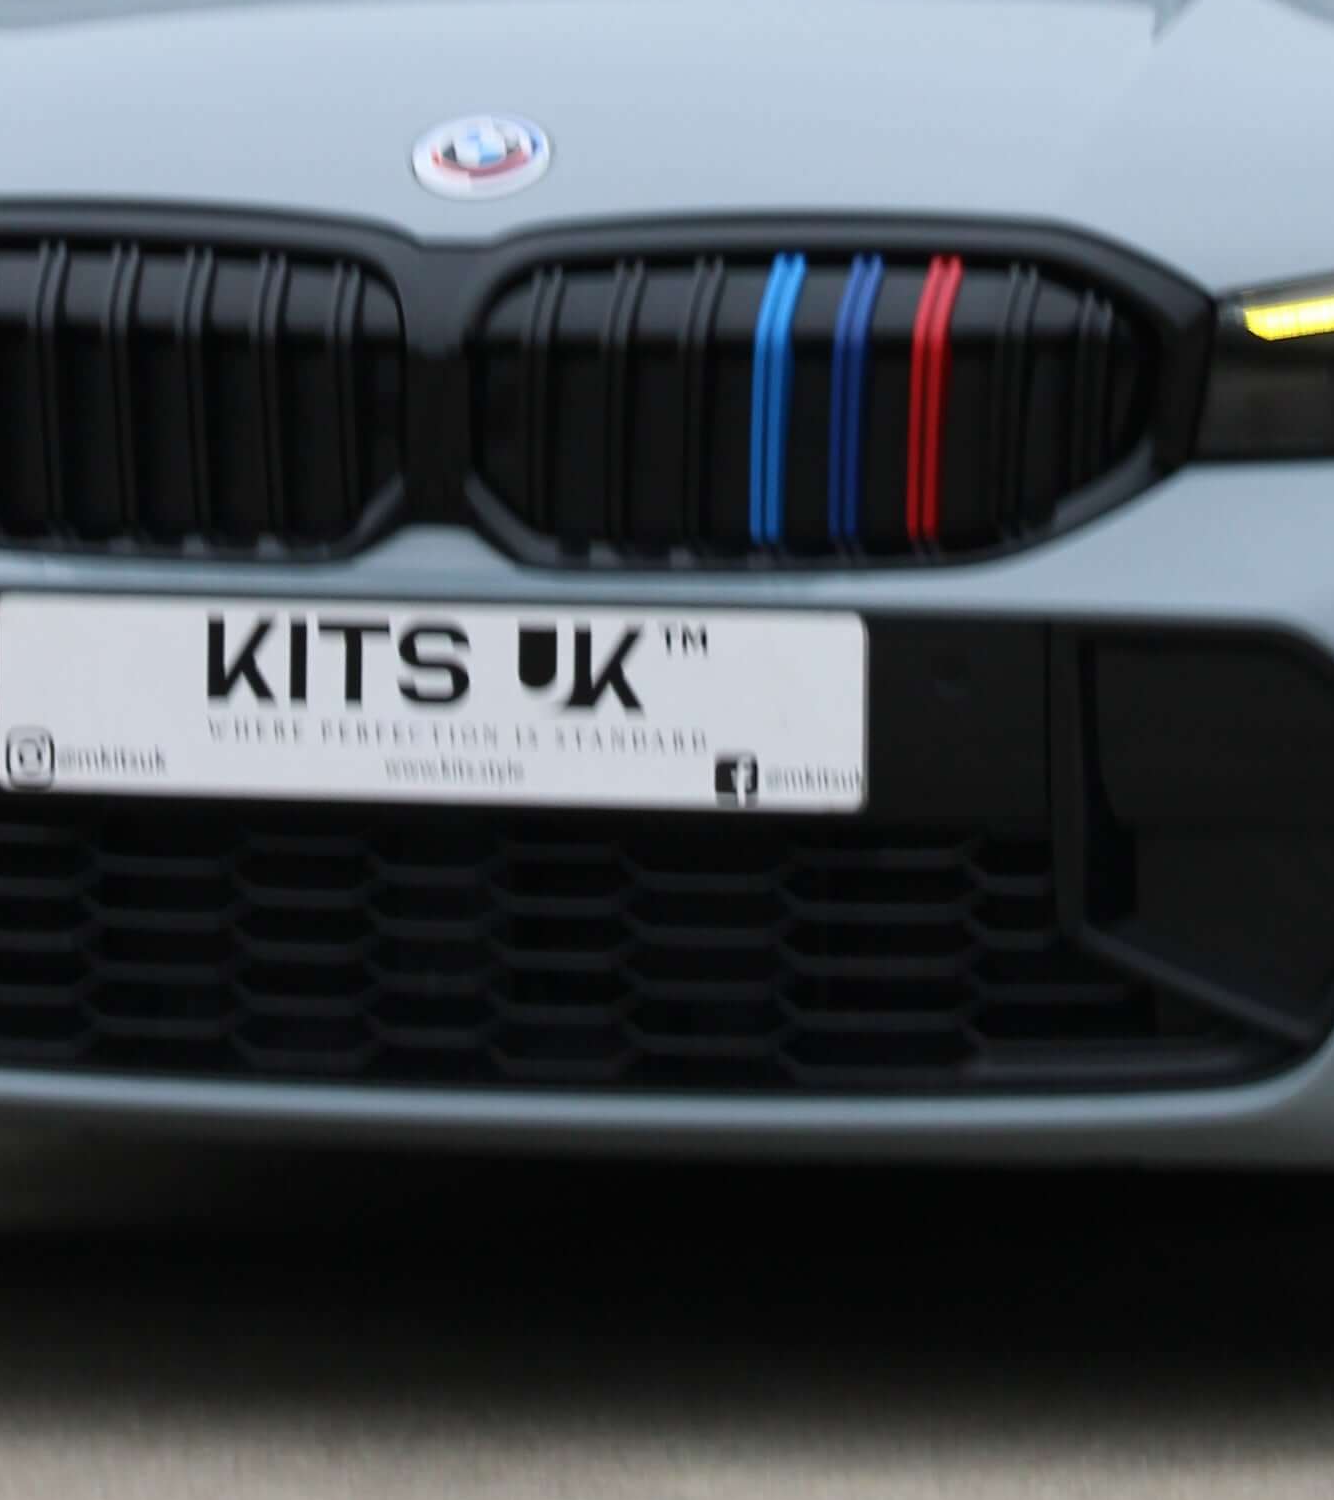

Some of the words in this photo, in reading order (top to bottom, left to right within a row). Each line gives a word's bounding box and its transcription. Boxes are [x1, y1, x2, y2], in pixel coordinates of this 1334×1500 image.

[205, 614, 471, 706] KITS
[516, 626, 645, 716] UK
[207, 718, 306, 745] WHERE
[317, 720, 500, 750] PERFECTION
[555, 724, 709, 754] STANDARD
